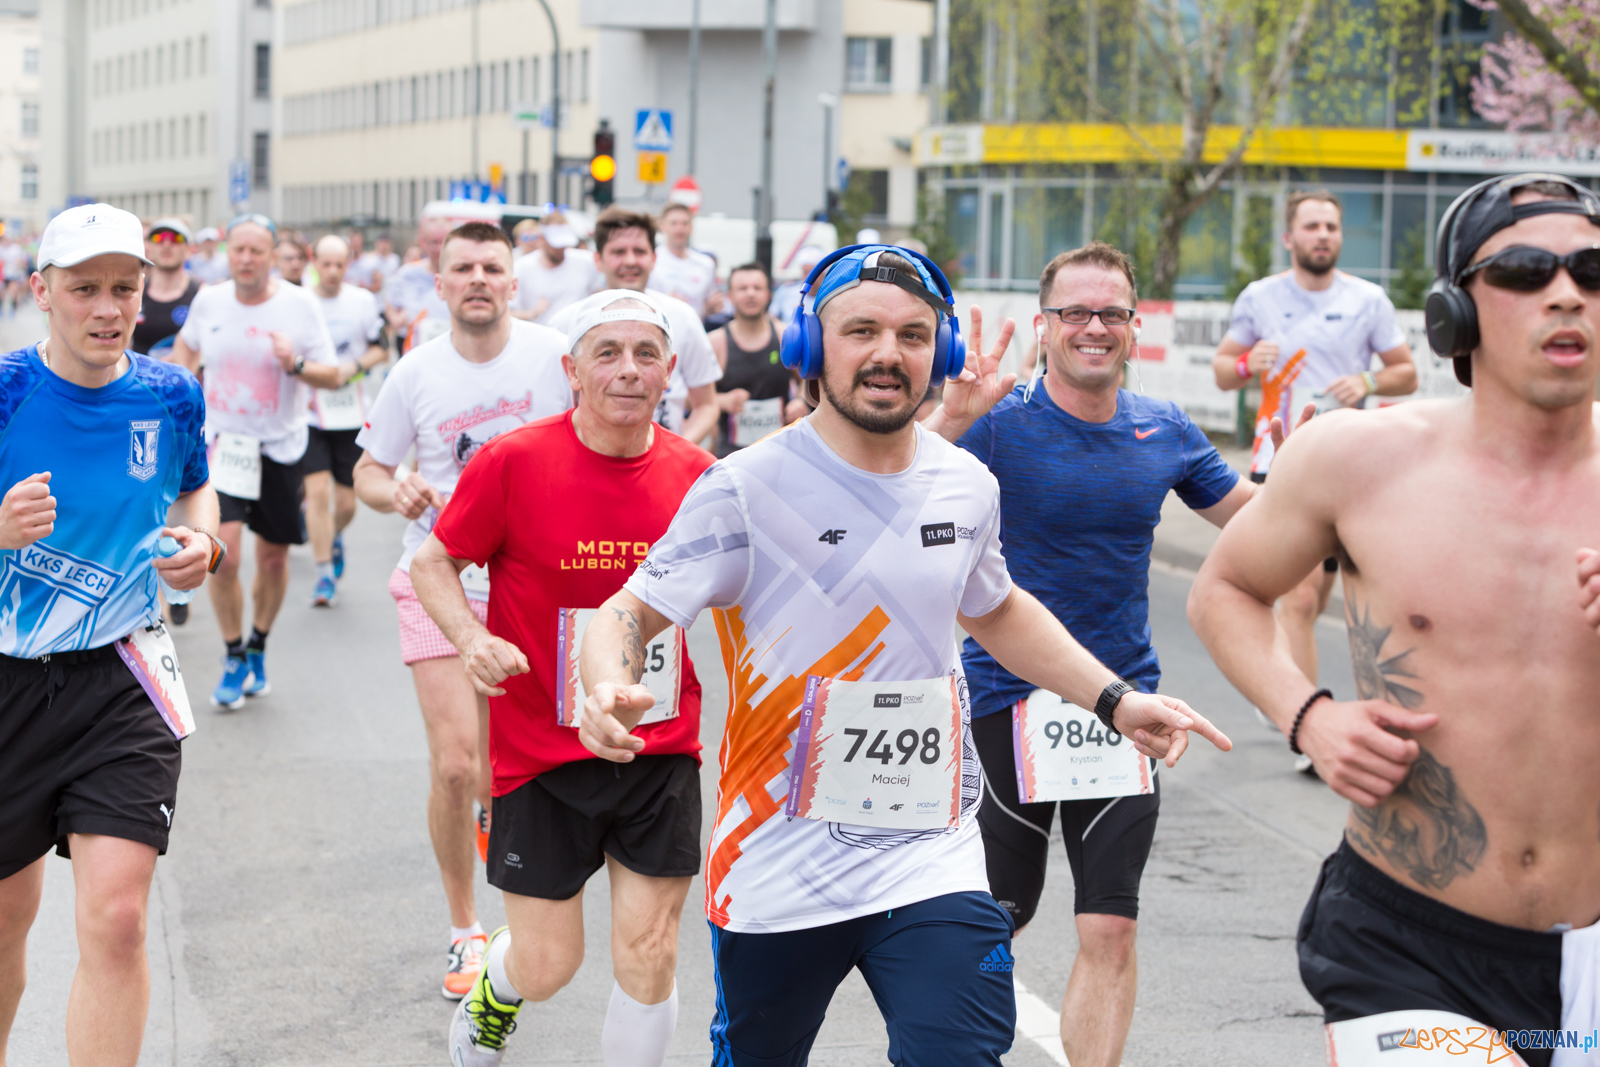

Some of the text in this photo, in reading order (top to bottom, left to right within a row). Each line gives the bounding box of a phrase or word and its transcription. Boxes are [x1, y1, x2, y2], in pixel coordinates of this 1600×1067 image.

[818, 529, 847, 545] 4F
[925, 528, 953, 540] 11.PKO
[577, 540, 655, 556] MOTO
[24, 548, 110, 594] KKS LECH
[560, 557, 626, 570] LUBOŃ
[843, 727, 941, 766] 7498
[1070, 754, 1103, 765] Krystian
[871, 773, 911, 788] Maciej
